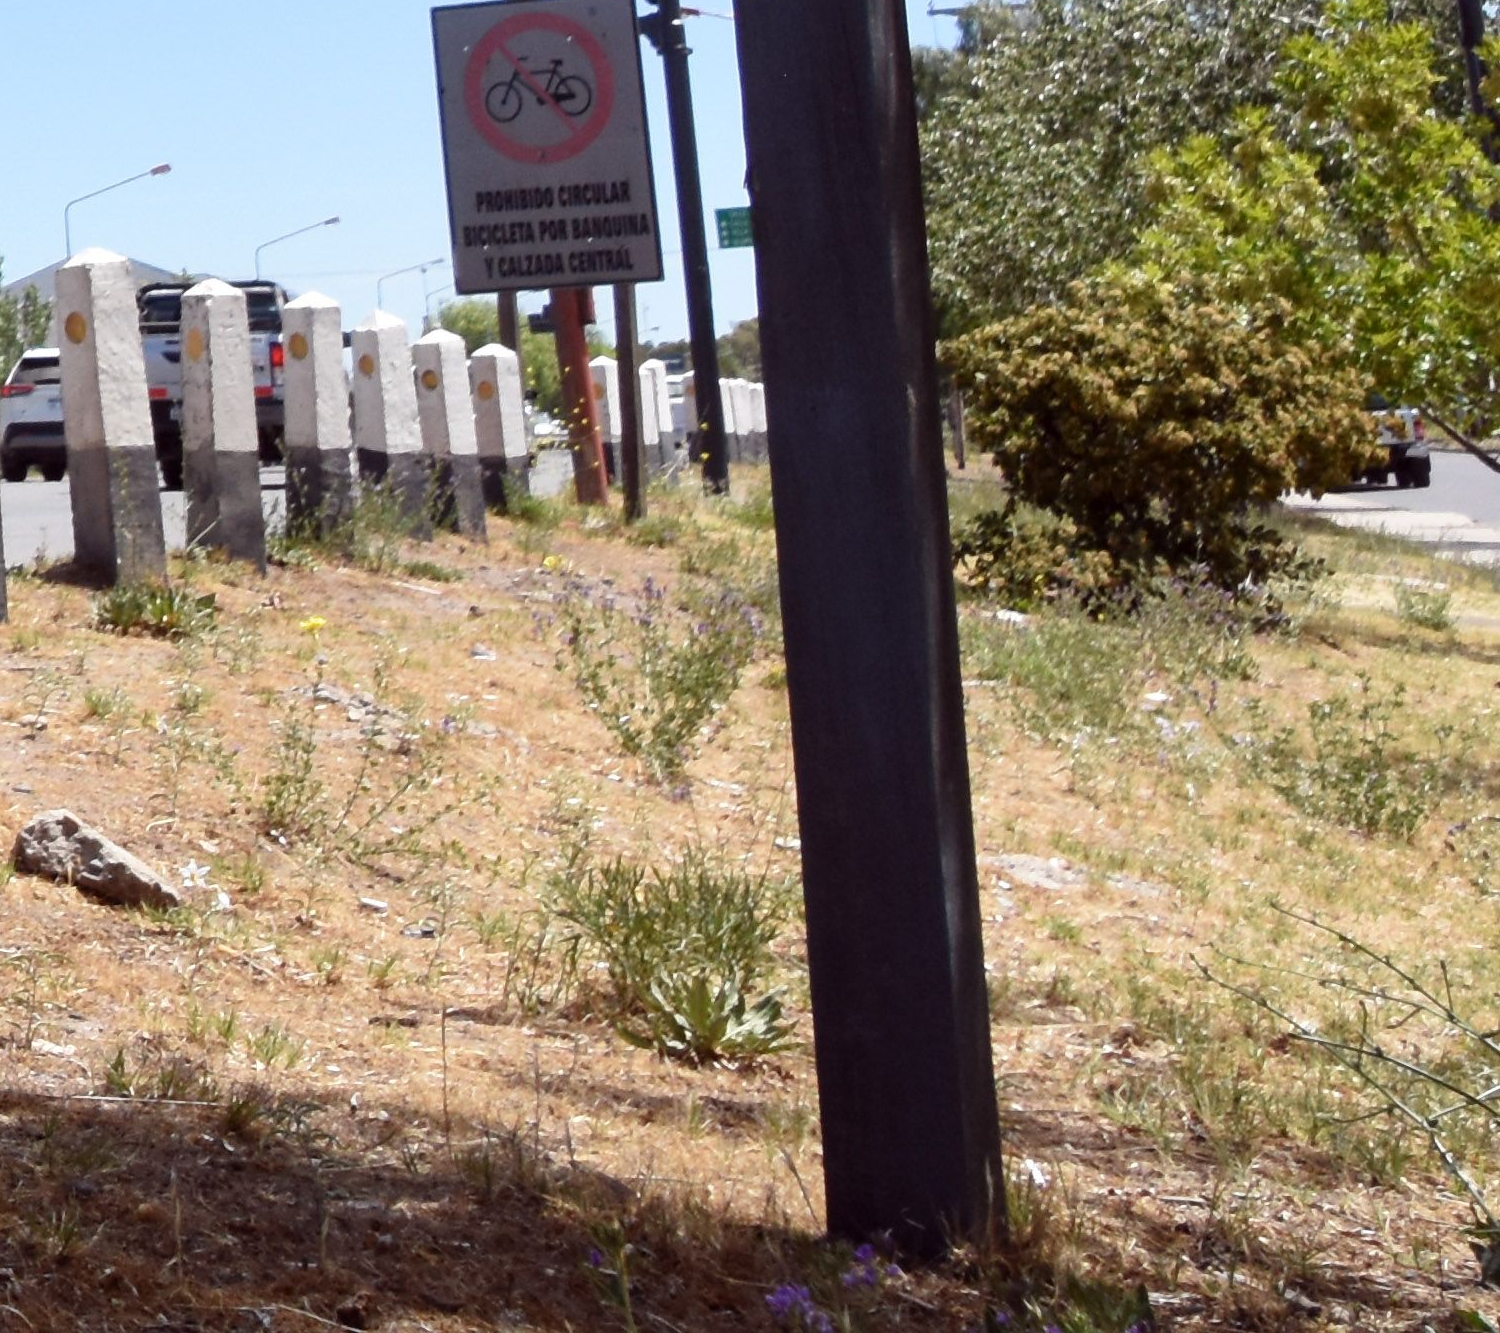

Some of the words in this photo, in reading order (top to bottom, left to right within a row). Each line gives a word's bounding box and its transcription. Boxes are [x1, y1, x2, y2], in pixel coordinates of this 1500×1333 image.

[476, 186, 554, 213] PROHIBIDO
[558, 180, 631, 207] CIRCULAR
[463, 221, 535, 247] BICICLETA
[539, 218, 569, 242] POR
[572, 213, 650, 240] BANQUINA
[484, 257, 495, 279] Y
[500, 253, 564, 277] CALZADA
